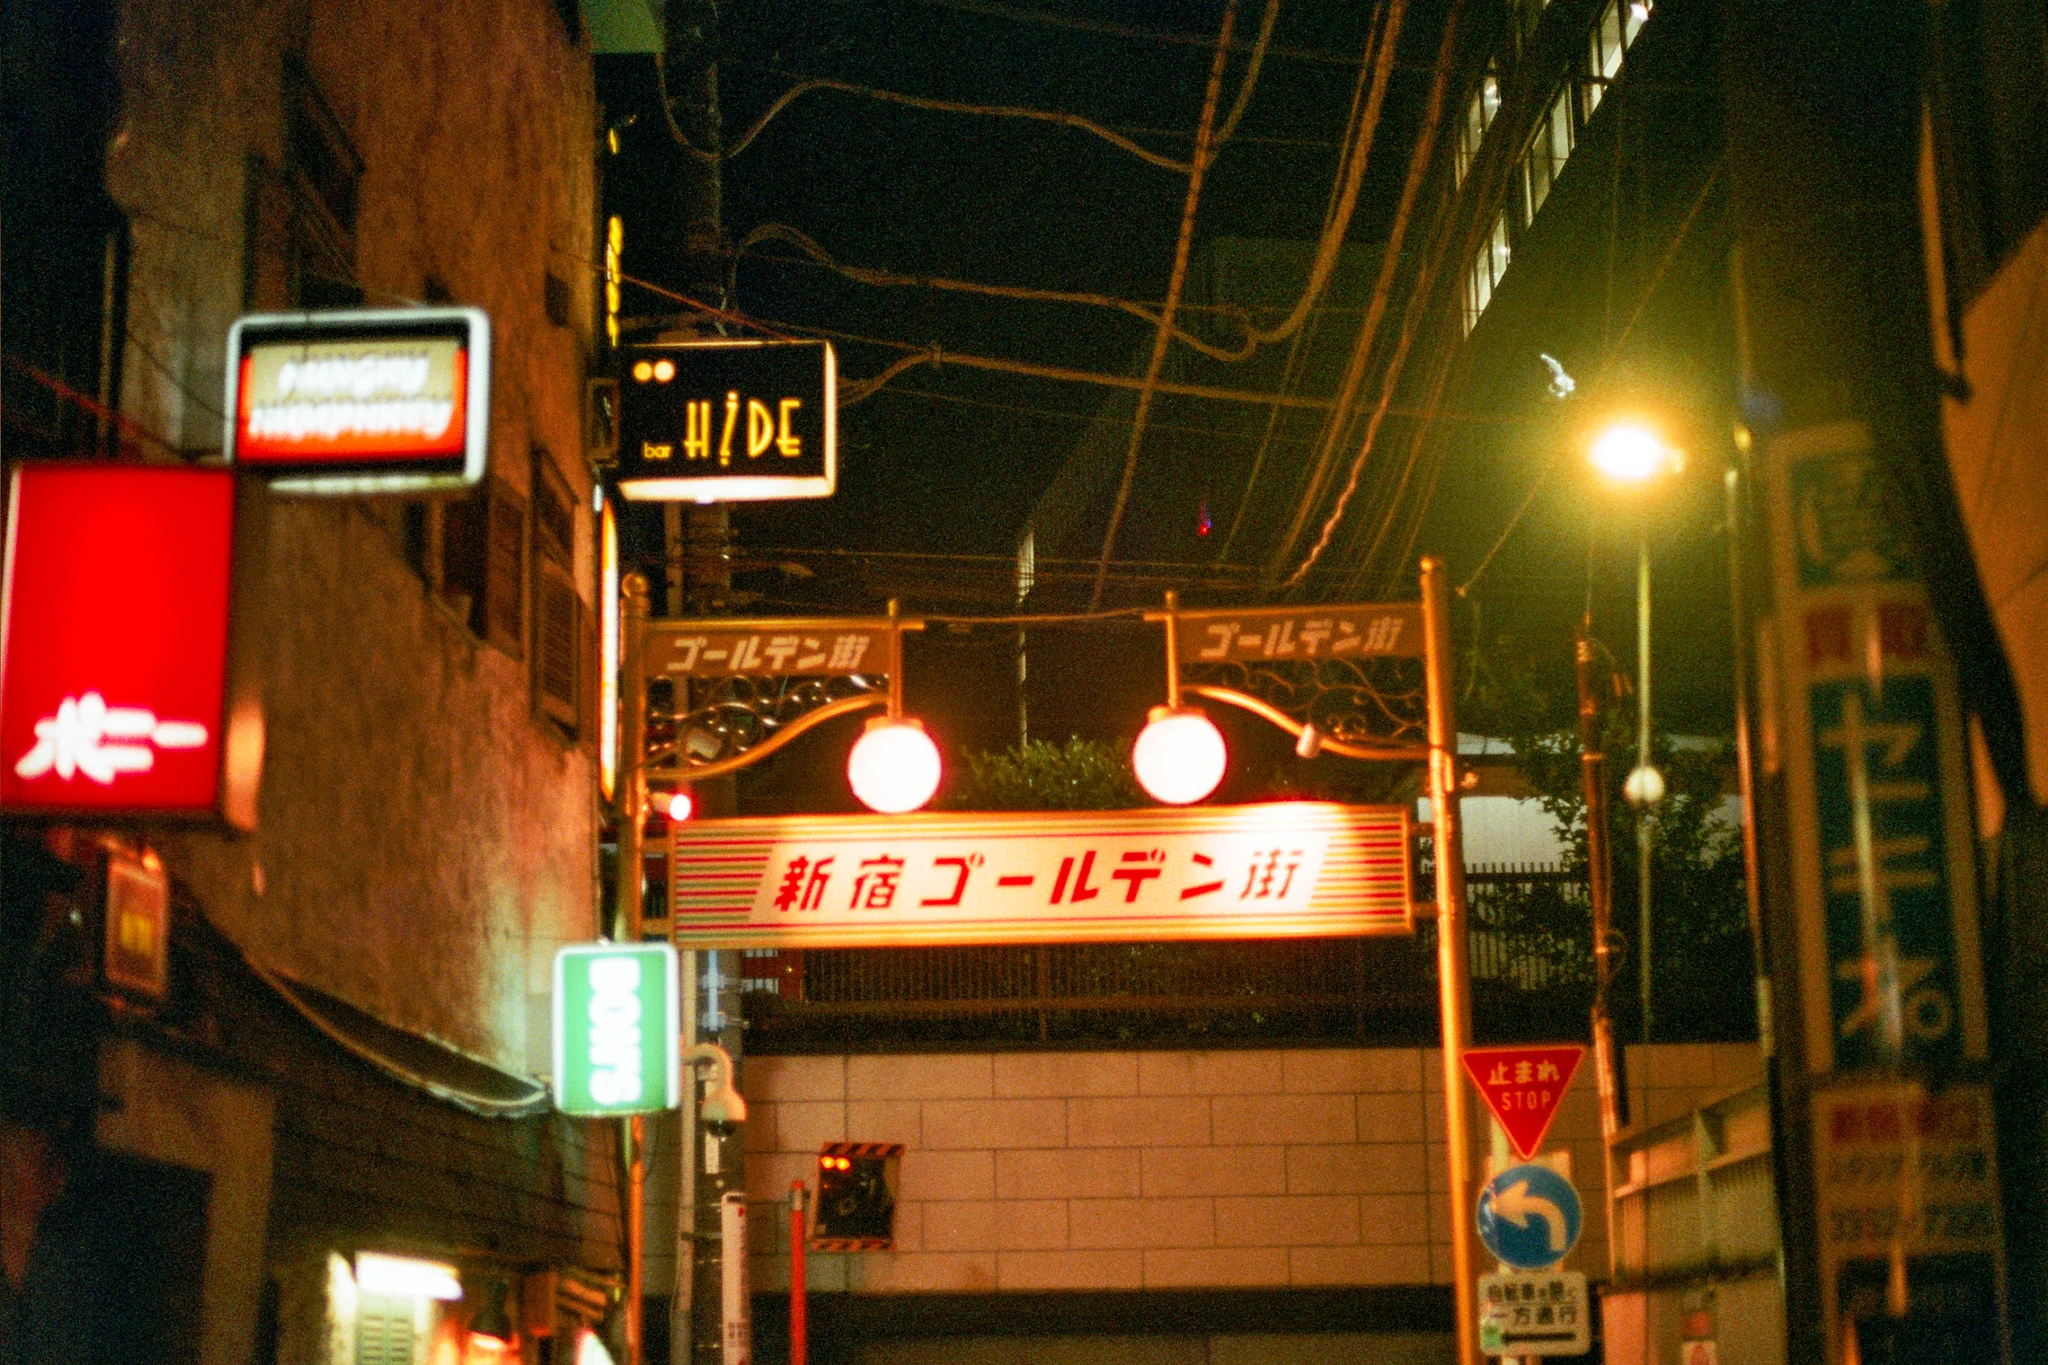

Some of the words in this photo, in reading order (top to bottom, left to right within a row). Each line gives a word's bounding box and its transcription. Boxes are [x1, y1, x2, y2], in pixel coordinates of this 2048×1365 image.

[642, 442, 672, 460] bar
[1200, 616, 1406, 657] ゴールデン街
[666, 634, 870, 673] ゴールデン街
[774, 847, 1306, 913] 新宿ゴールデン街
[1488, 1058, 1561, 1085] 止まれ
[1501, 1090, 1551, 1111] STOP
